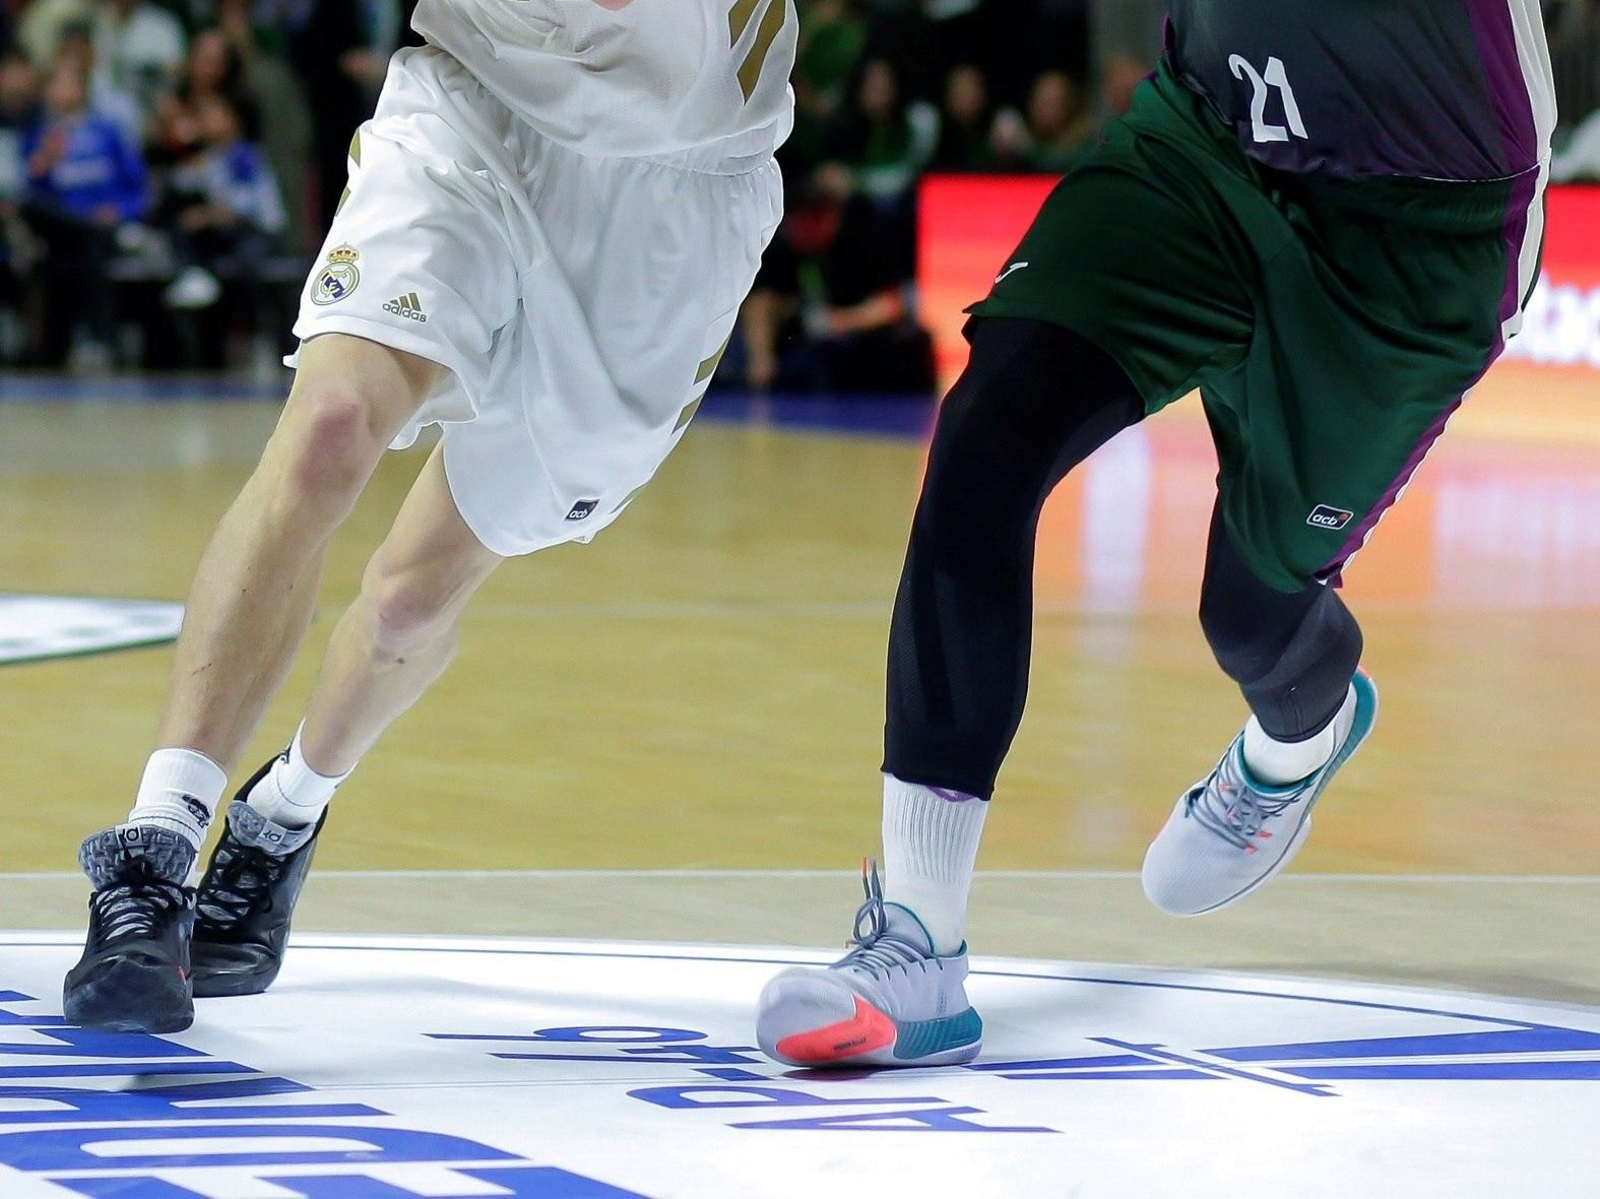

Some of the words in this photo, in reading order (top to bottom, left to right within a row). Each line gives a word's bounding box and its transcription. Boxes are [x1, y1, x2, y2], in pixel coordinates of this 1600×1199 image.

[1228, 53, 1309, 143] 21
[382, 303, 428, 323] adidas
[1312, 514, 1338, 526] acb
